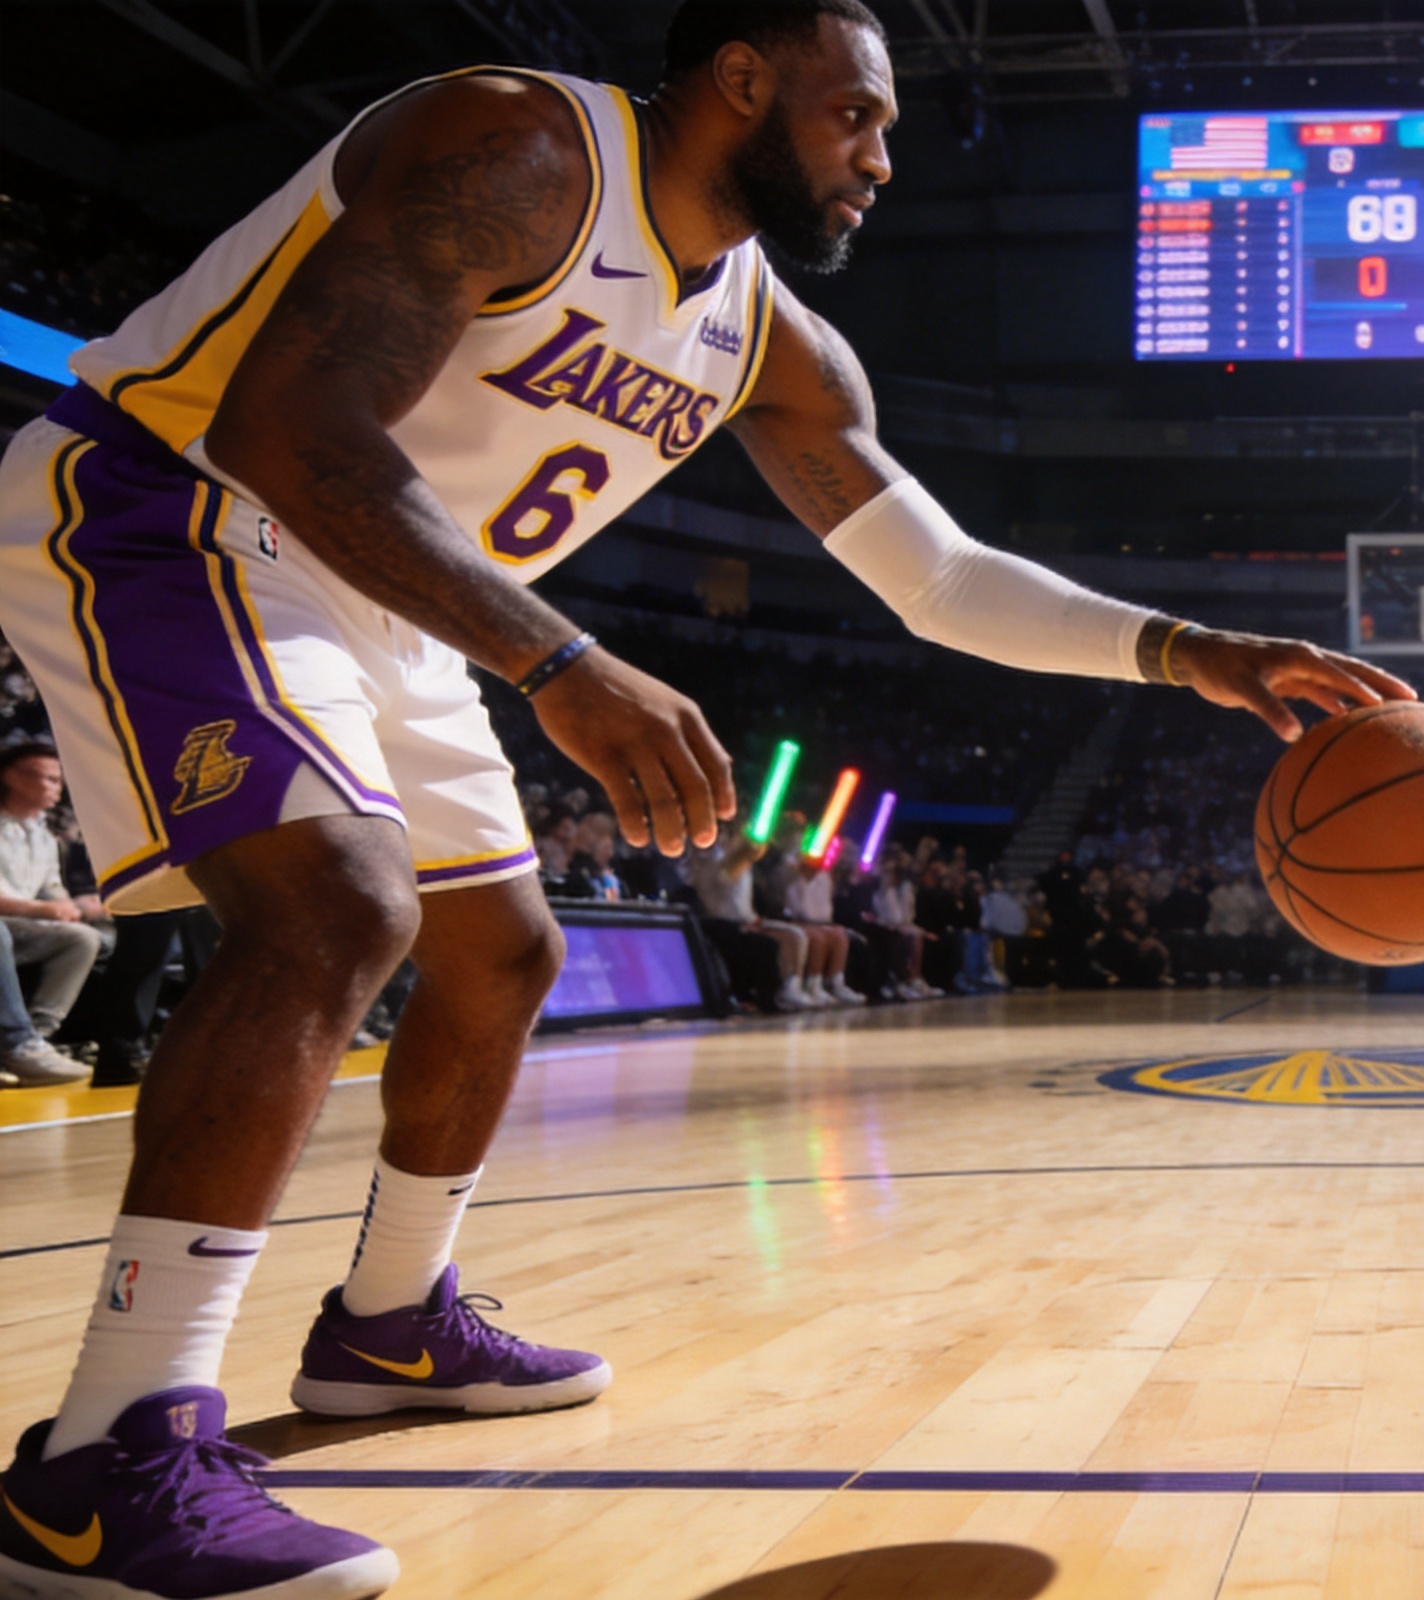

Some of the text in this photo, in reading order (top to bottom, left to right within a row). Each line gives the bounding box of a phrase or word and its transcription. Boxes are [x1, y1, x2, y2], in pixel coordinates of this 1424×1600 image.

[1358, 256, 1387, 297] 0
[477, 307, 720, 461] LAKERS
[480, 440, 611, 566] 6
